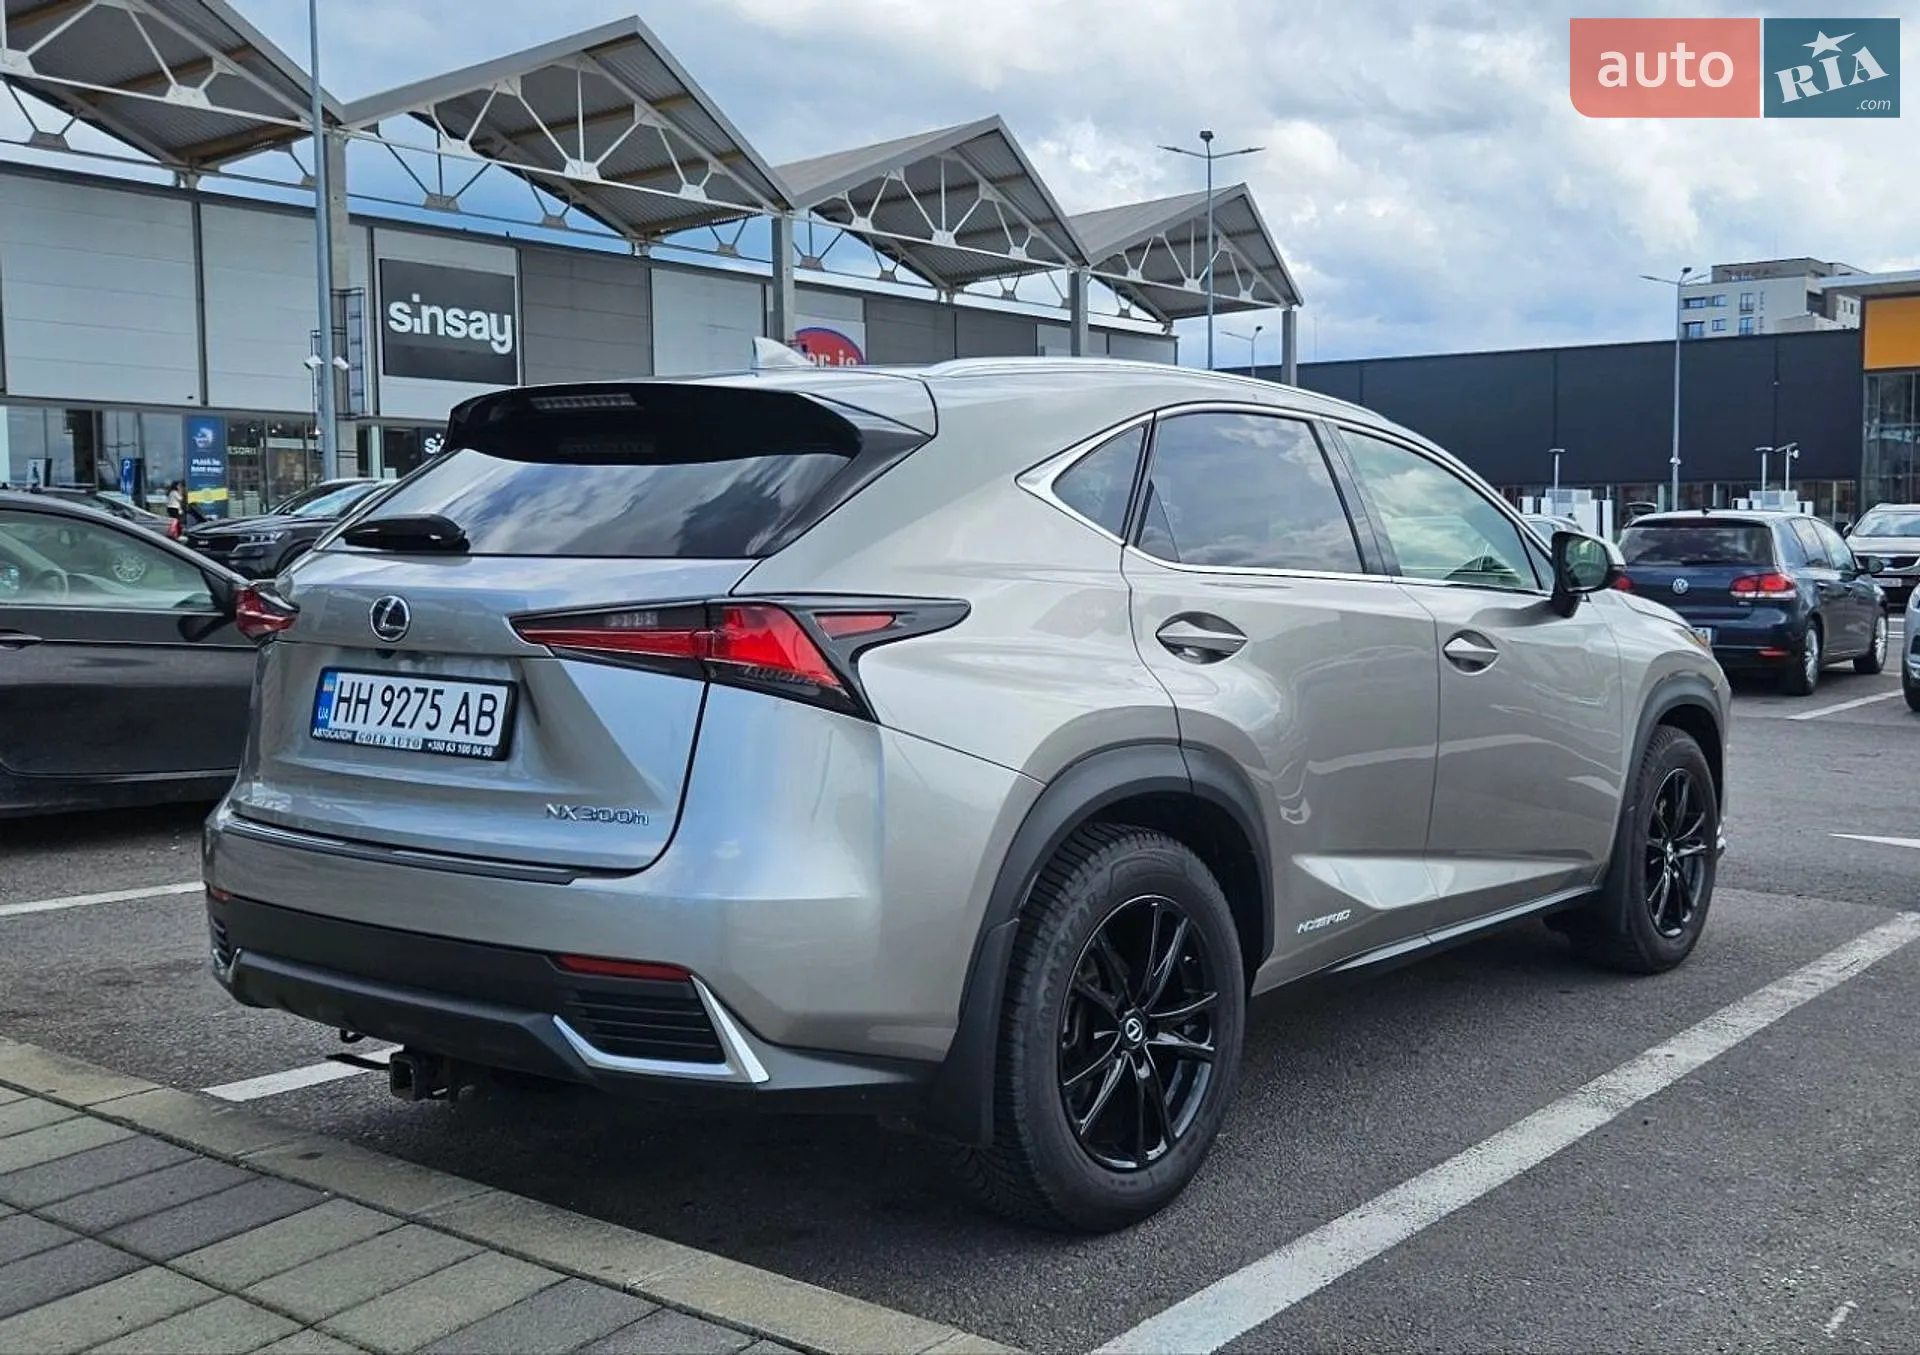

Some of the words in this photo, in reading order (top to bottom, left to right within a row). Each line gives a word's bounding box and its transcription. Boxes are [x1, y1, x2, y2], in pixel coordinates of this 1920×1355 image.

[388, 293, 513, 354] sinsay
[333, 680, 374, 725] HH
[377, 684, 445, 731] 9275
[450, 691, 498, 737] AB
[389, 735, 420, 749] AUTO
